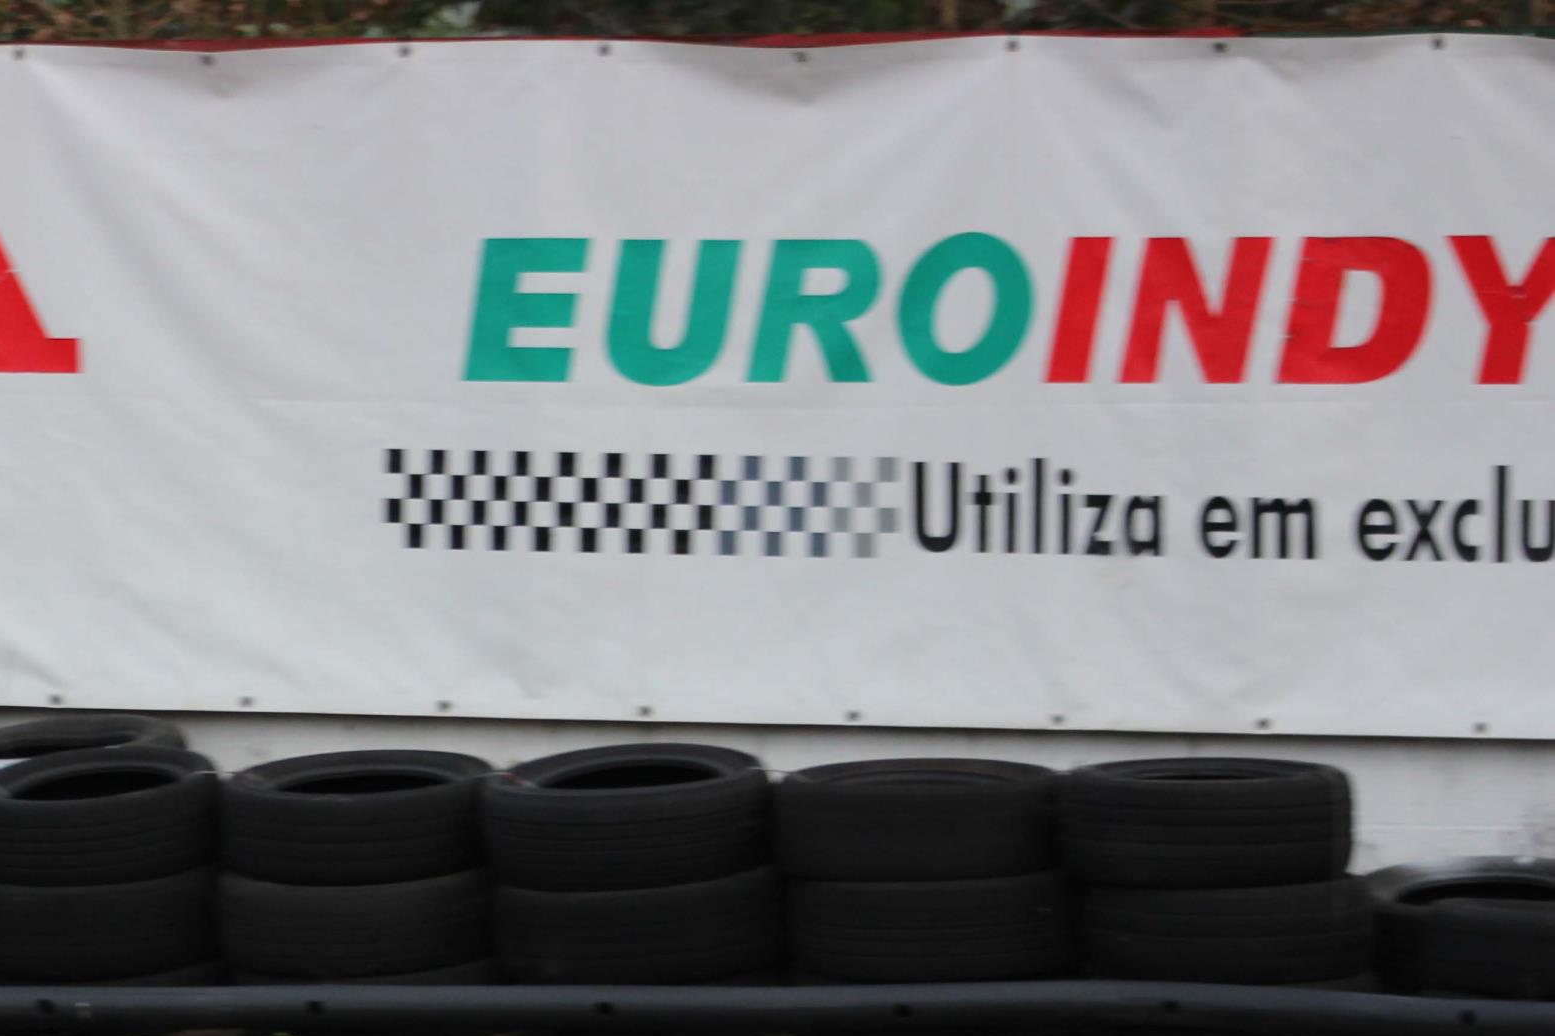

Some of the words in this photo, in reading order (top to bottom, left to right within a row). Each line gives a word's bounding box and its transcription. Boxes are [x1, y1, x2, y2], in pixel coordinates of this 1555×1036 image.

[461, 231, 1555, 385] EUROINDY
[910, 457, 1167, 558] Utiliza
[1200, 494, 1320, 559] em
[1355, 464, 1555, 563] exclu
